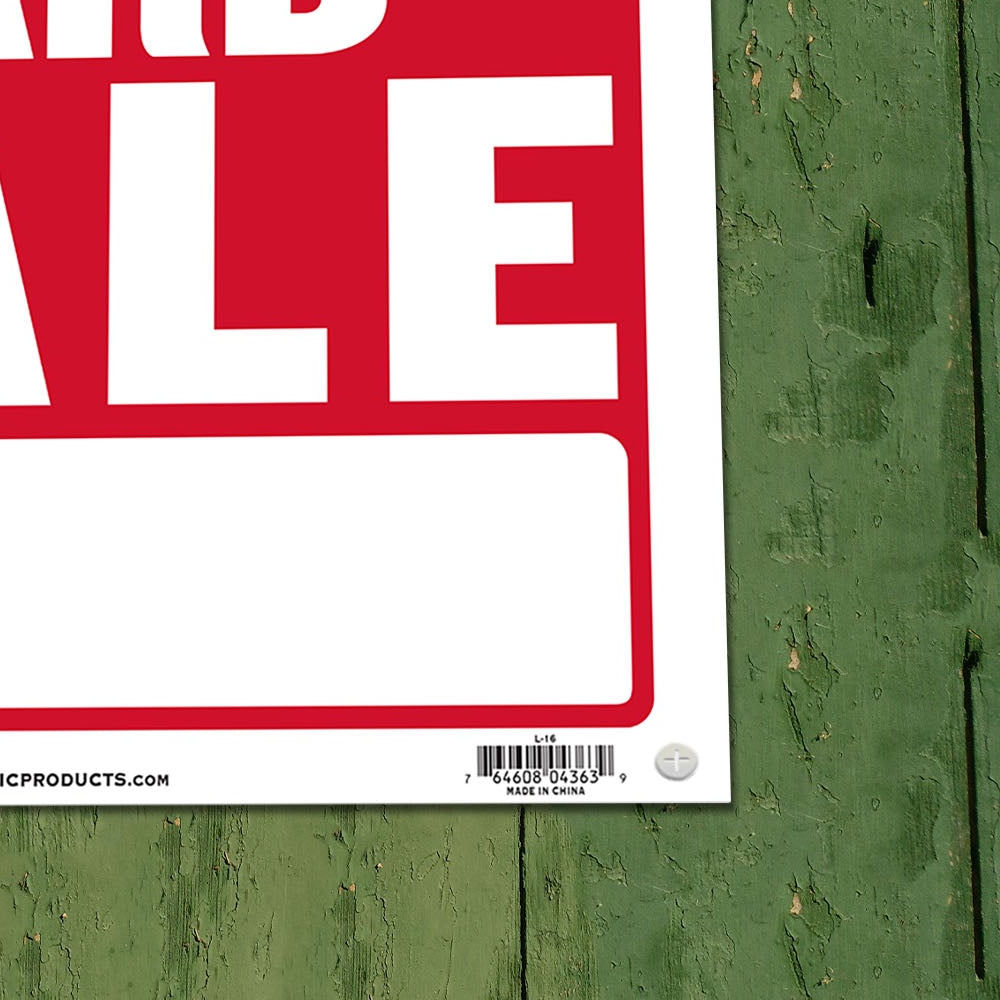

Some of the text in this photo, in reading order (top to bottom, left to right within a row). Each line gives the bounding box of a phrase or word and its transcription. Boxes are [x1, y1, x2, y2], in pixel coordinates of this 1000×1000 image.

[534, 734, 557, 744] L-16
[464, 770, 627, 784] 7 64608 04363 9
[506, 786, 586, 796] MADE IN CHINA
